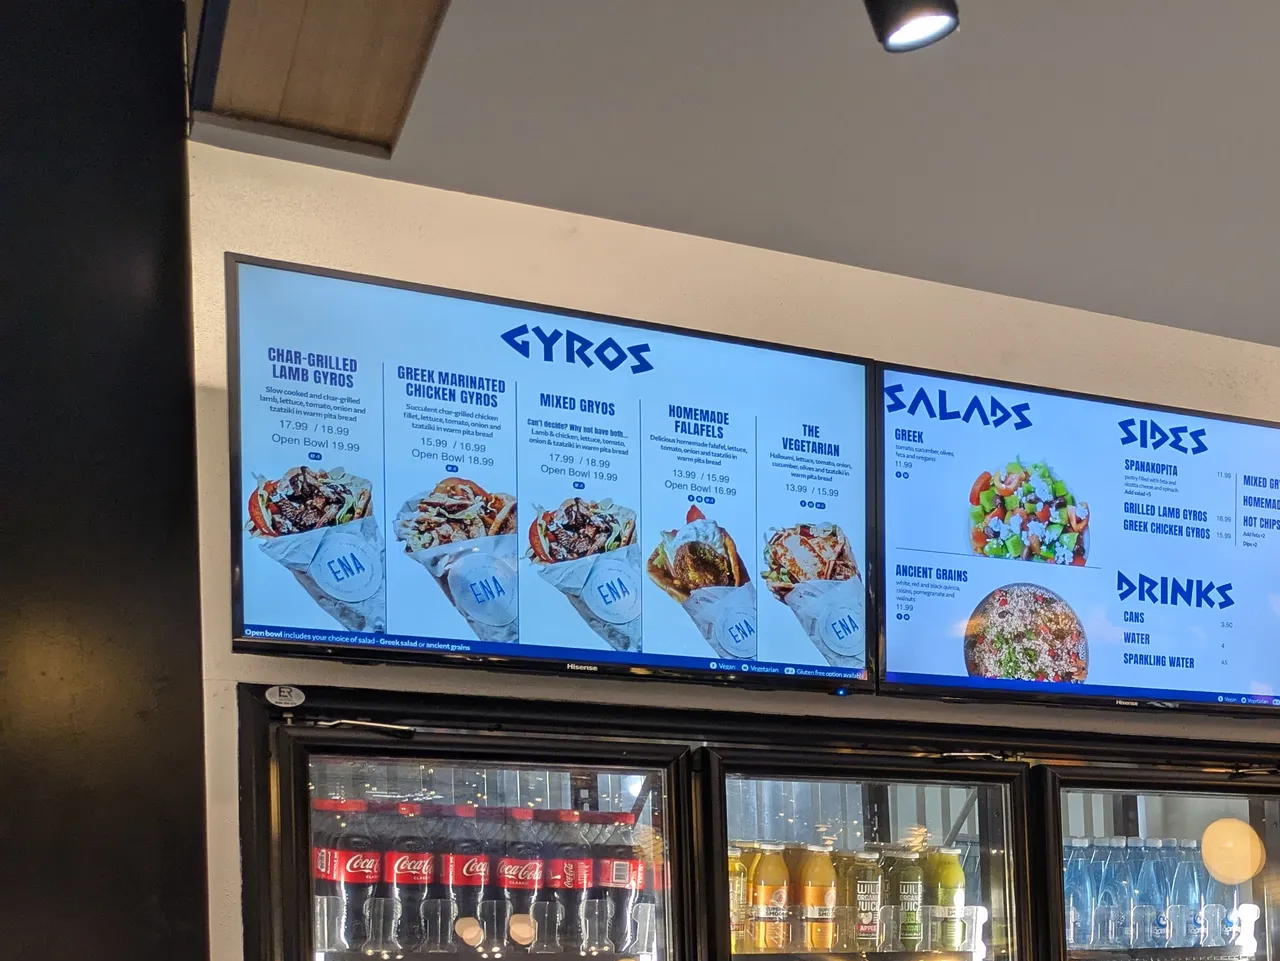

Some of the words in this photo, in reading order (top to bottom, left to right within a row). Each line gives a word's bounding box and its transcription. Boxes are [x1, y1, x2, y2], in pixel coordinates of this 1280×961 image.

[500, 324, 654, 374] GYROS
[268, 347, 357, 372] CHAR-GRILLED
[272, 364, 309, 382] LAMB
[314, 370, 354, 388] GYROS
[397, 366, 434, 383] GREEK
[439, 371, 505, 393] MARINATED
[266, 386, 283, 394] Slow
[284, 390, 308, 398] cooked
[406, 383, 455, 402] CHICKEN
[461, 390, 498, 407] GYROS
[540, 393, 575, 411] MIXED
[580, 399, 615, 416] GRYOS
[884, 383, 1033, 431] SALADS
[270, 406, 294, 414] tzatziki
[324, 412, 336, 420] pita
[338, 414, 357, 422] bread
[669, 405, 729, 425] HOMEMADE
[280, 420, 308, 431] 17.99
[322, 425, 349, 436] 18.99
[544, 421, 568, 430] decide?
[570, 424, 582, 433] Why
[595, 428, 609, 436] have
[675, 420, 723, 439] FALAFELS
[802, 424, 820, 438] THE
[895, 428, 923, 443] GREEK
[1118, 417, 1208, 455] SIDES
[272, 434, 300, 445] Open
[304, 438, 328, 448] Bowl
[333, 442, 360, 452] 19.99
[421, 437, 447, 448] 15.99
[460, 442, 486, 453] 16.99
[782, 437, 839, 457] VEGETARIAN
[412, 449, 438, 459] Open
[442, 452, 464, 463] Bowl
[468, 456, 494, 466] 18.99
[549, 453, 574, 464] 17.99
[586, 458, 610, 468] 18.99
[895, 461, 912, 469] 11.99
[541, 464, 565, 475] Open
[569, 468, 590, 478] Bowl
[594, 472, 618, 482] 19.99
[673, 469, 696, 479] 13.99
[707, 474, 729, 483] 15.99
[1124, 459, 1178, 477] SPANAKOPITA
[665, 480, 688, 490] Open
[691, 483, 711, 493] Bowl
[715, 486, 736, 496] 16.99
[786, 484, 807, 493] 13.99
[818, 488, 838, 497] 15.99
[1244, 475, 1267, 488] MIXED
[1124, 502, 1155, 516] GRILLED
[1158, 506, 1180, 519] LAMB
[1183, 509, 1207, 522] GYROS
[1124, 519, 1148, 532] GREEK
[1151, 522, 1183, 536] CHICKEN
[1186, 526, 1210, 539] GYROS
[1243, 516, 1257, 527] HOT
[1260, 518, 1280, 530] CHIPS
[327, 552, 365, 582] ENA
[896, 564, 932, 578] ANCIENT
[936, 568, 968, 582] GRAINS
[469, 576, 506, 604] ENA
[597, 578, 630, 605] ENA
[1117, 570, 1235, 609] DRINKS
[1123, 611, 1145, 623] CANS
[728, 619, 755, 644] ENA
[831, 615, 859, 640] ENA
[244, 629, 264, 637] Open
[265, 629, 282, 638] bowl
[283, 631, 311, 640] includes
[312, 633, 326, 642] your
[328, 634, 349, 642] choice
[350, 635, 357, 643] of
[358, 636, 375, 645] salad
[380, 638, 400, 646] Greek
[400, 639, 418, 647] salad
[426, 641, 450, 650] ancient
[450, 643, 470, 651] grains
[1123, 632, 1150, 645] WATER
[567, 663, 598, 672] Hisense
[751, 665, 779, 673] Vegetarian
[1123, 653, 1166, 666] SPARKLING
[1169, 656, 1194, 668] WATER
